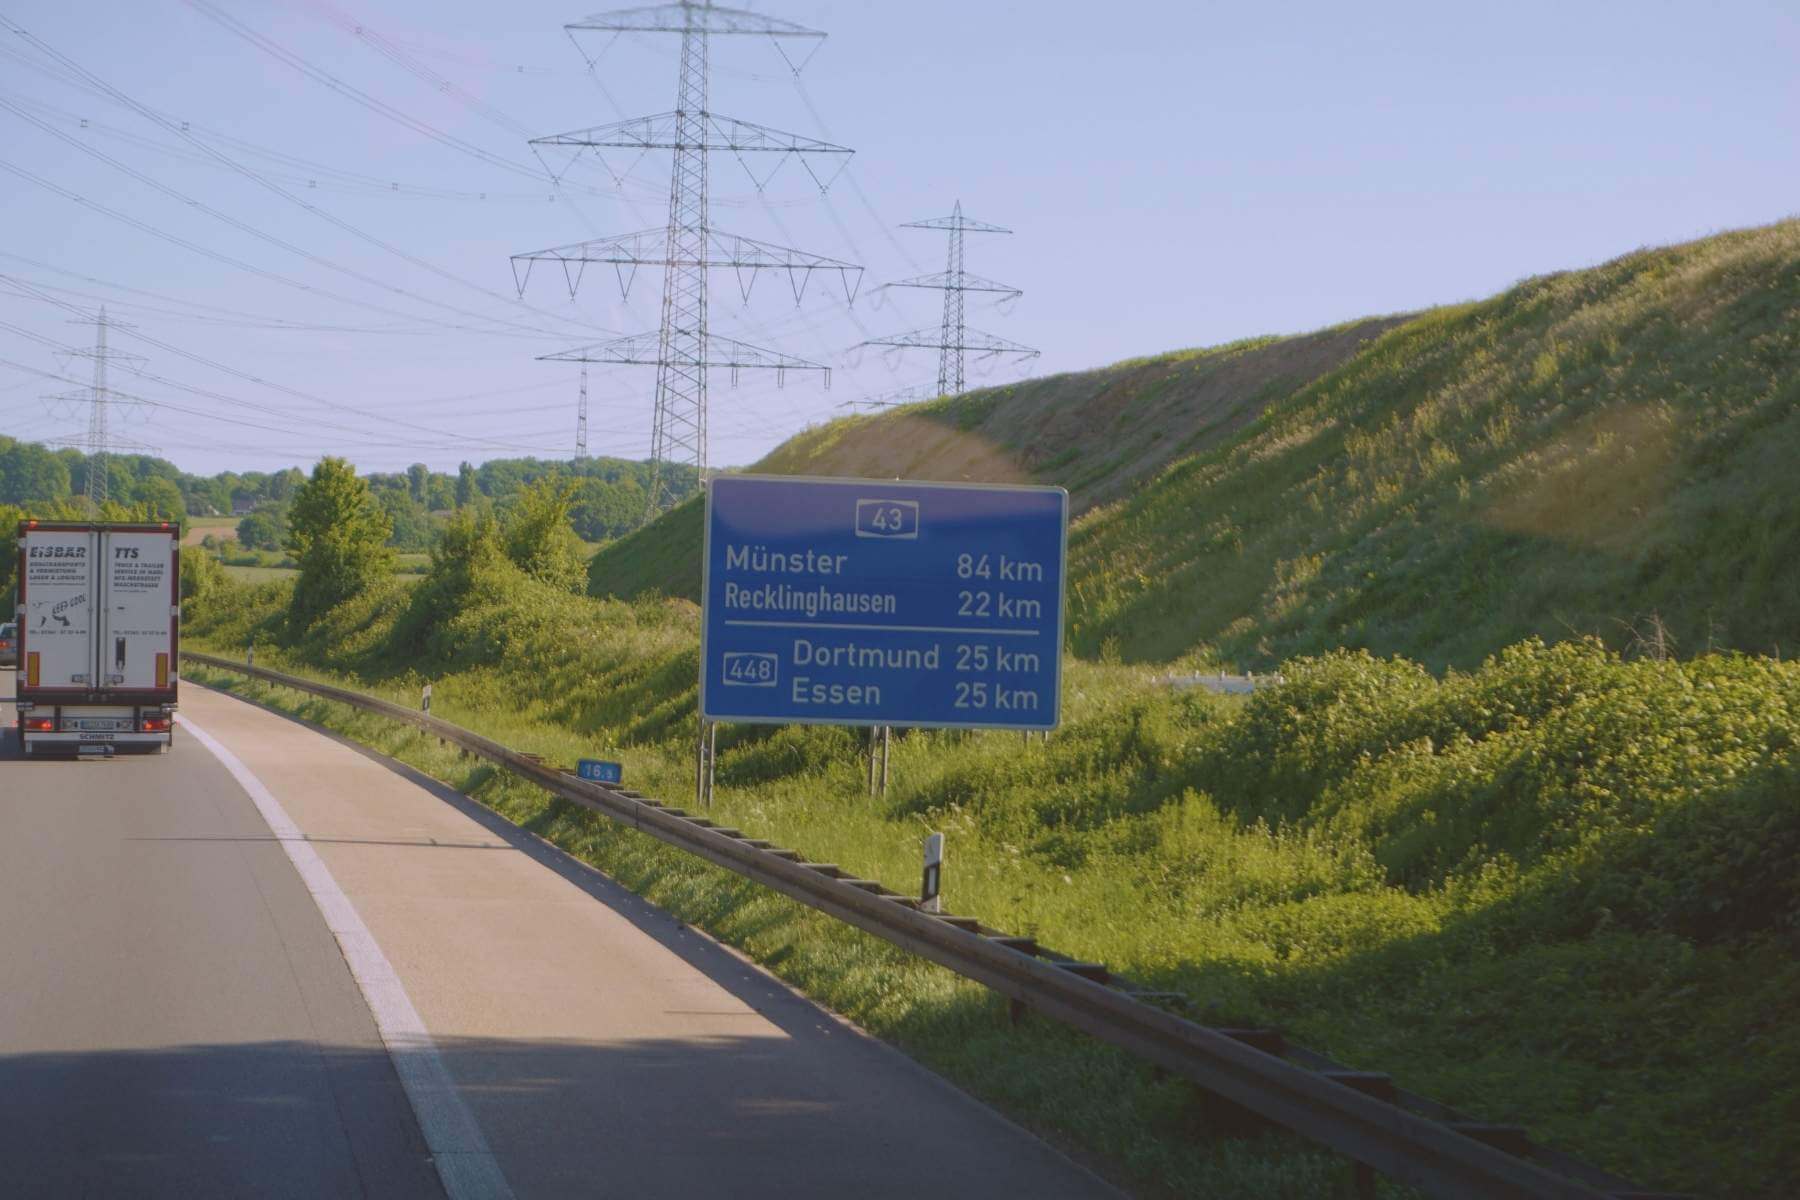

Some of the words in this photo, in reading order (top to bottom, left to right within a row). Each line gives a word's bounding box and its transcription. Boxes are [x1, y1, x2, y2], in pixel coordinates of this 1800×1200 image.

[872, 507, 903, 531] 43
[115, 547, 139, 559] TTS
[726, 544, 848, 575] Münster
[957, 553, 991, 580] 84
[1000, 554, 1043, 582] km
[725, 582, 897, 617] Recklinghausen
[958, 591, 991, 616] 22
[998, 591, 1041, 618] km
[730, 659, 771, 680] 448
[793, 639, 940, 670] Dortmund
[956, 645, 988, 670] 25
[997, 645, 1040, 672] km
[792, 677, 881, 705] Essen
[954, 682, 987, 708] 25
[995, 682, 1038, 710] km
